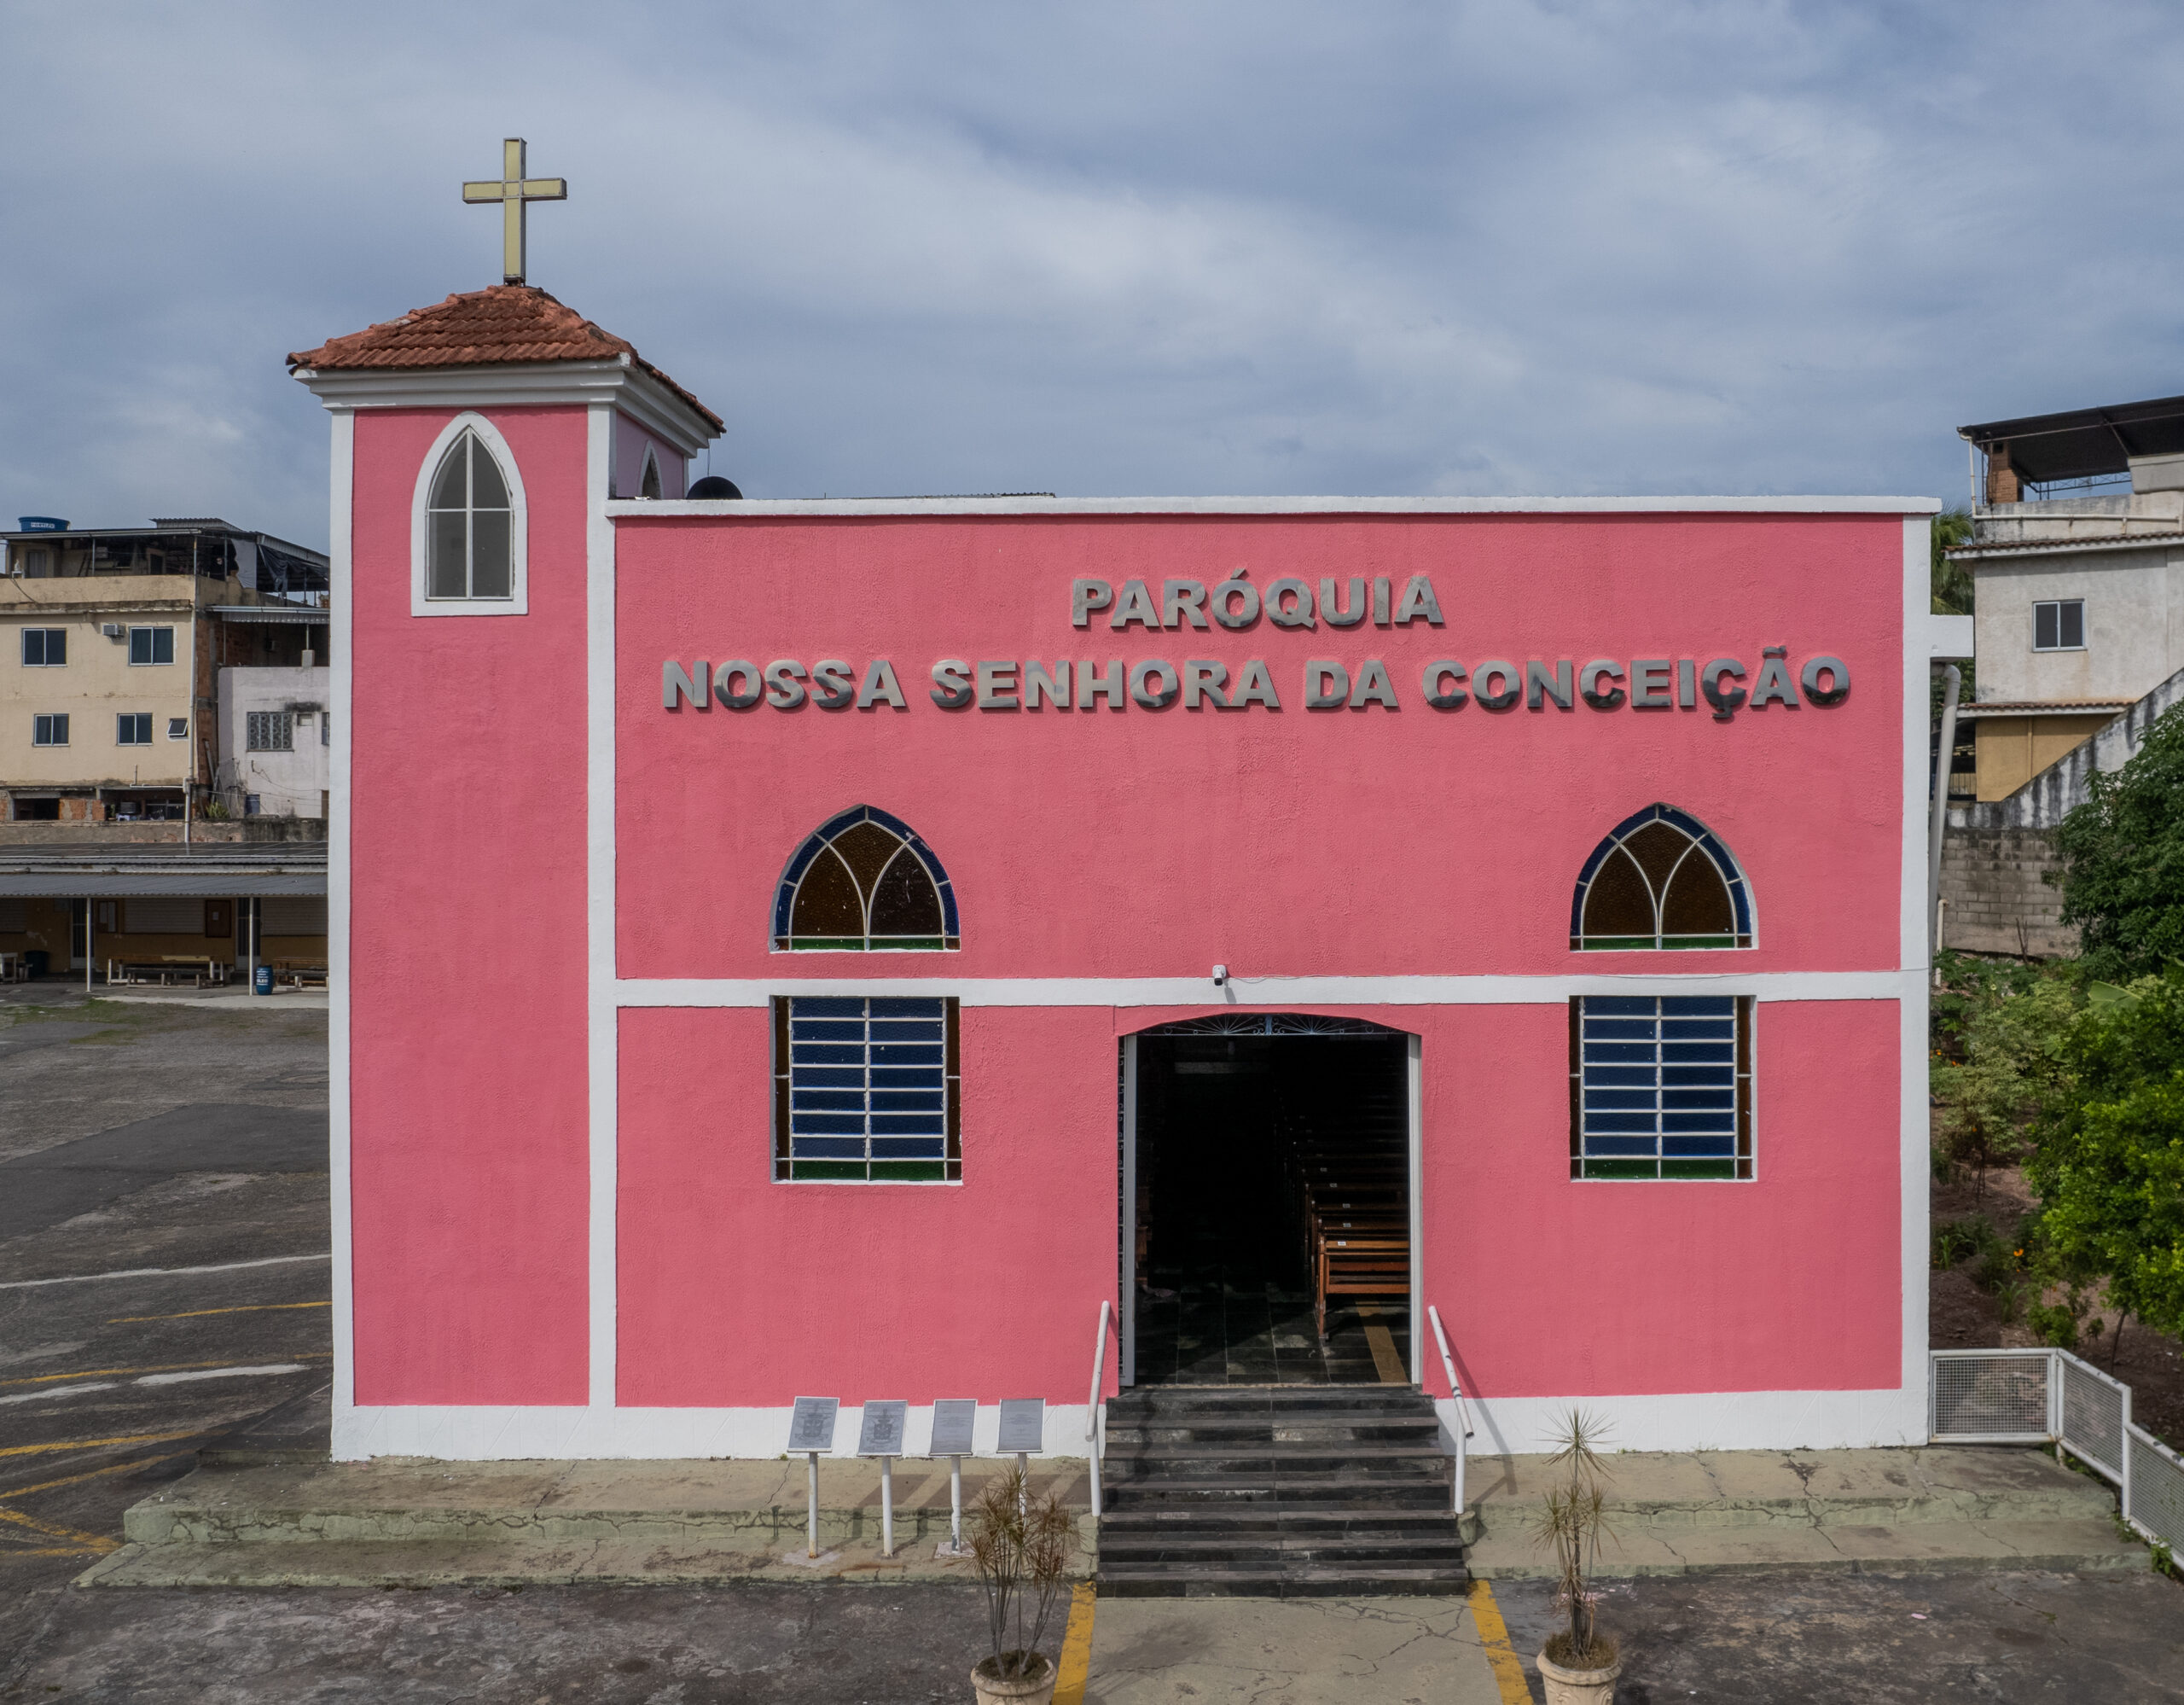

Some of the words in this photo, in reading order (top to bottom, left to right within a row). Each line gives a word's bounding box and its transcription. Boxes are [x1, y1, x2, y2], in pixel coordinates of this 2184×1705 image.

[1072, 568, 1443, 628] PARÓQUIA
[662, 660, 907, 707] NOSSA
[929, 659, 1280, 708] SENHORA
[1305, 660, 1398, 707] DA
[1421, 645, 1850, 719] CONCEIÇÃO
